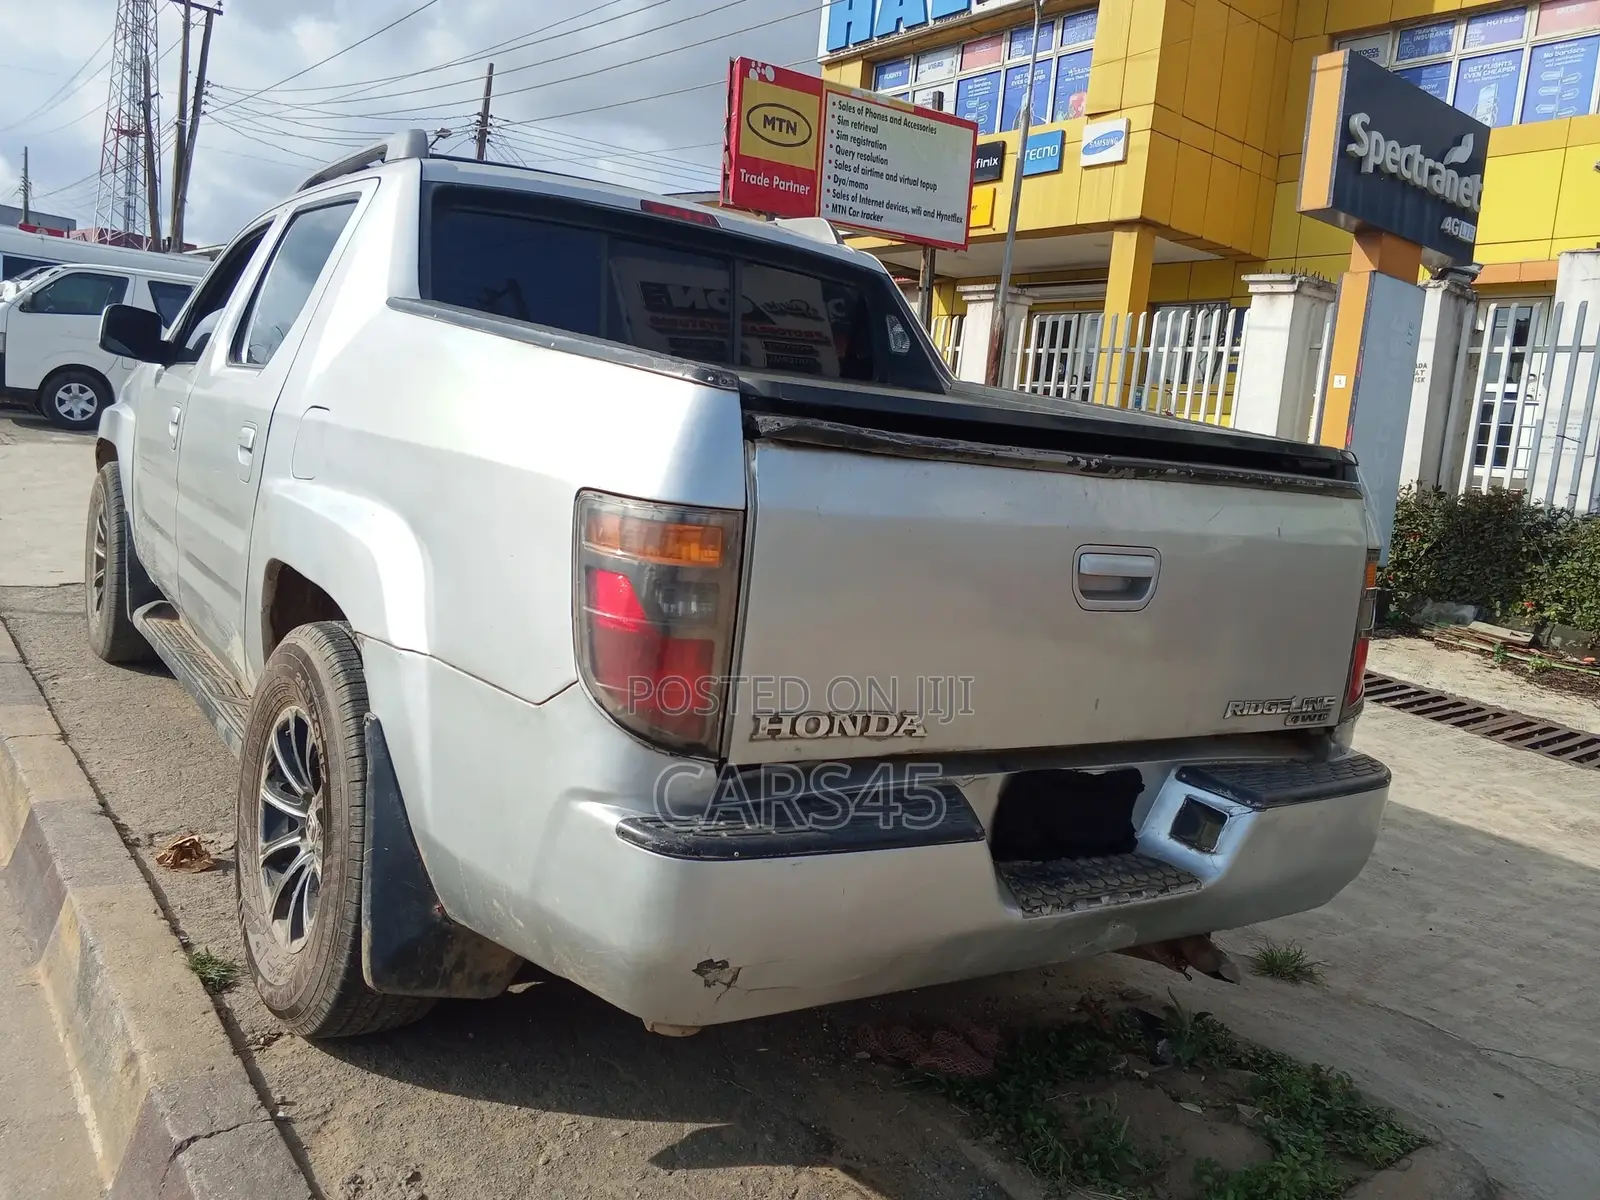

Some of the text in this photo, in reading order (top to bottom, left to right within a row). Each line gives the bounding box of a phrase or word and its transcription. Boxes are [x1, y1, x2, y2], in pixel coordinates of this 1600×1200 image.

[827, 0, 972, 52] HA
[1486, 15, 1520, 26] HOTELS
[1413, 29, 1453, 41] INSURANCE
[1464, 71, 1481, 79] EVEN
[1482, 66, 1516, 76] CHEAPER
[1483, 60, 1512, 70] FLIGHTS
[763, 114, 797, 136] MTN
[837, 115, 879, 134] Sim retrieval
[838, 100, 937, 135] Sales of Phones and Accessories
[836, 130, 887, 151] Sim registration
[1089, 137, 1119, 149] SAMSUNG
[835, 145, 888, 166] Query resolution
[1346, 112, 1483, 213] Spectranet
[740, 168, 811, 195] Trade Partner
[833, 174, 869, 190] Dya/momo
[834, 159, 938, 192] Sales of airtime and virtual topup
[831, 203, 884, 222] MTN Car tracker
[832, 189, 849, 201] Sales
[851, 193, 858, 203] of
[859, 194, 884, 208] Internet
[885, 200, 910, 214] devices,
[911, 206, 922, 216] wifi
[923, 209, 935, 218] and
[1441, 217, 1460, 237] 4G
[1223, 695, 1337, 720] RIDGELINE
[750, 710, 928, 741] HONDA
[1288, 712, 1329, 725] 4WD
